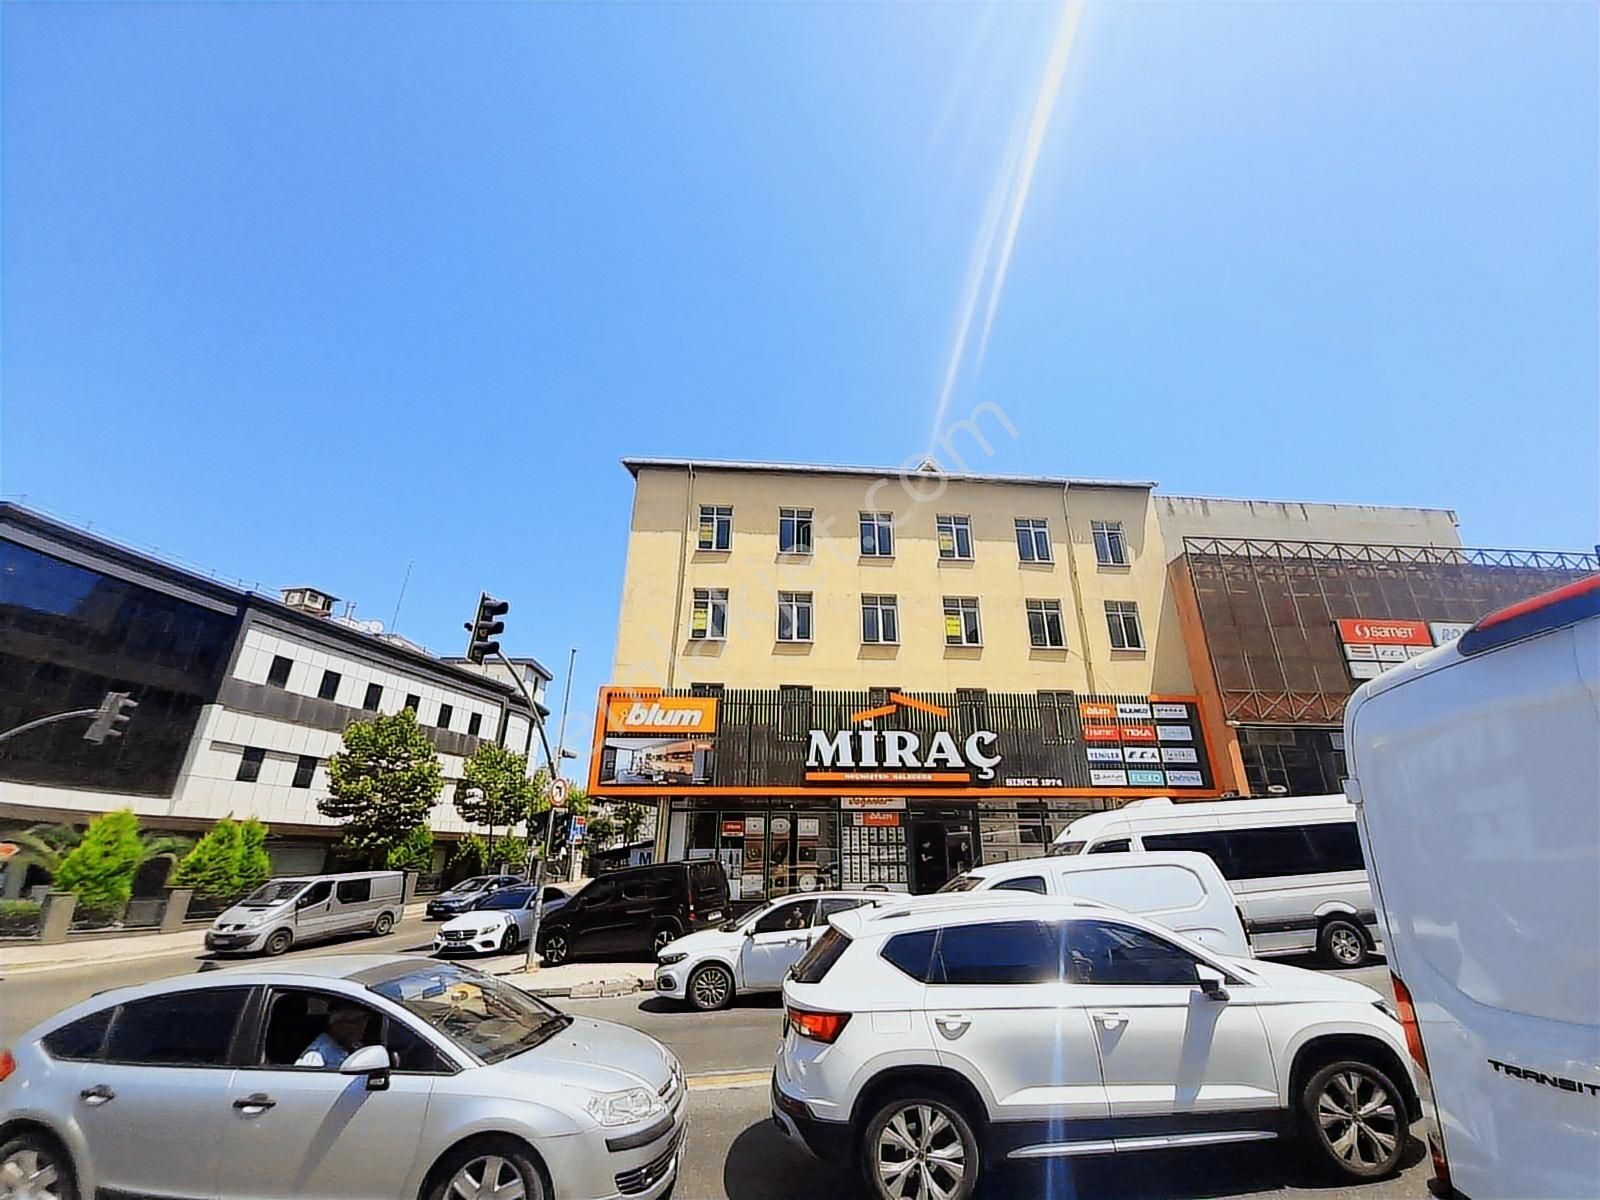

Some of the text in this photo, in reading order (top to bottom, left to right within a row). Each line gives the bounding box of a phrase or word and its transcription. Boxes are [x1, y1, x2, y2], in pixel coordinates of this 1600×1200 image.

[624, 702, 702, 726] blum
[805, 719, 1002, 780] MİRAÇ
[1005, 777, 1063, 787] SINCE 1974
[1487, 1058, 1600, 1096] TRANSIT
